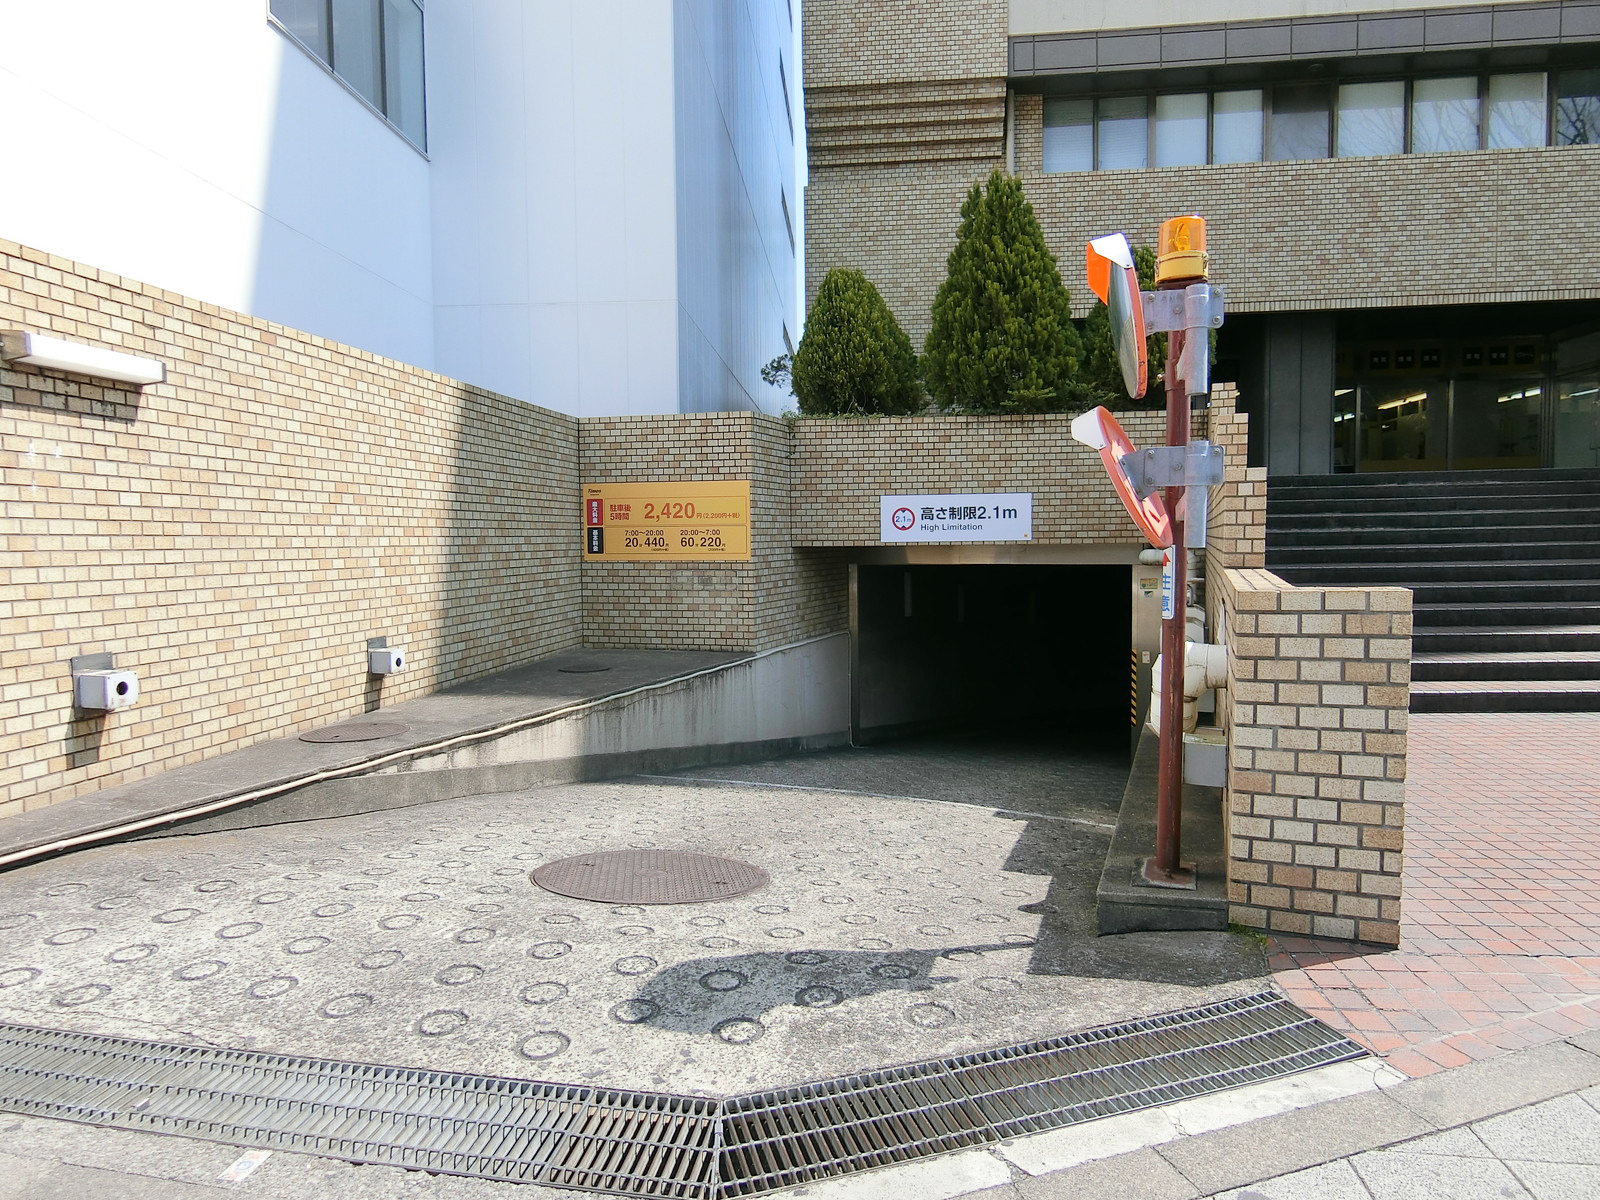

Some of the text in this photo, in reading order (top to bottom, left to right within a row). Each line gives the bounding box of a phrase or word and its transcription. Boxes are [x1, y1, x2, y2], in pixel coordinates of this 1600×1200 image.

[610, 504, 632, 512] 駐車後
[920, 506, 1018, 521] 高さ制限2.1m
[920, 524, 940, 532] High
